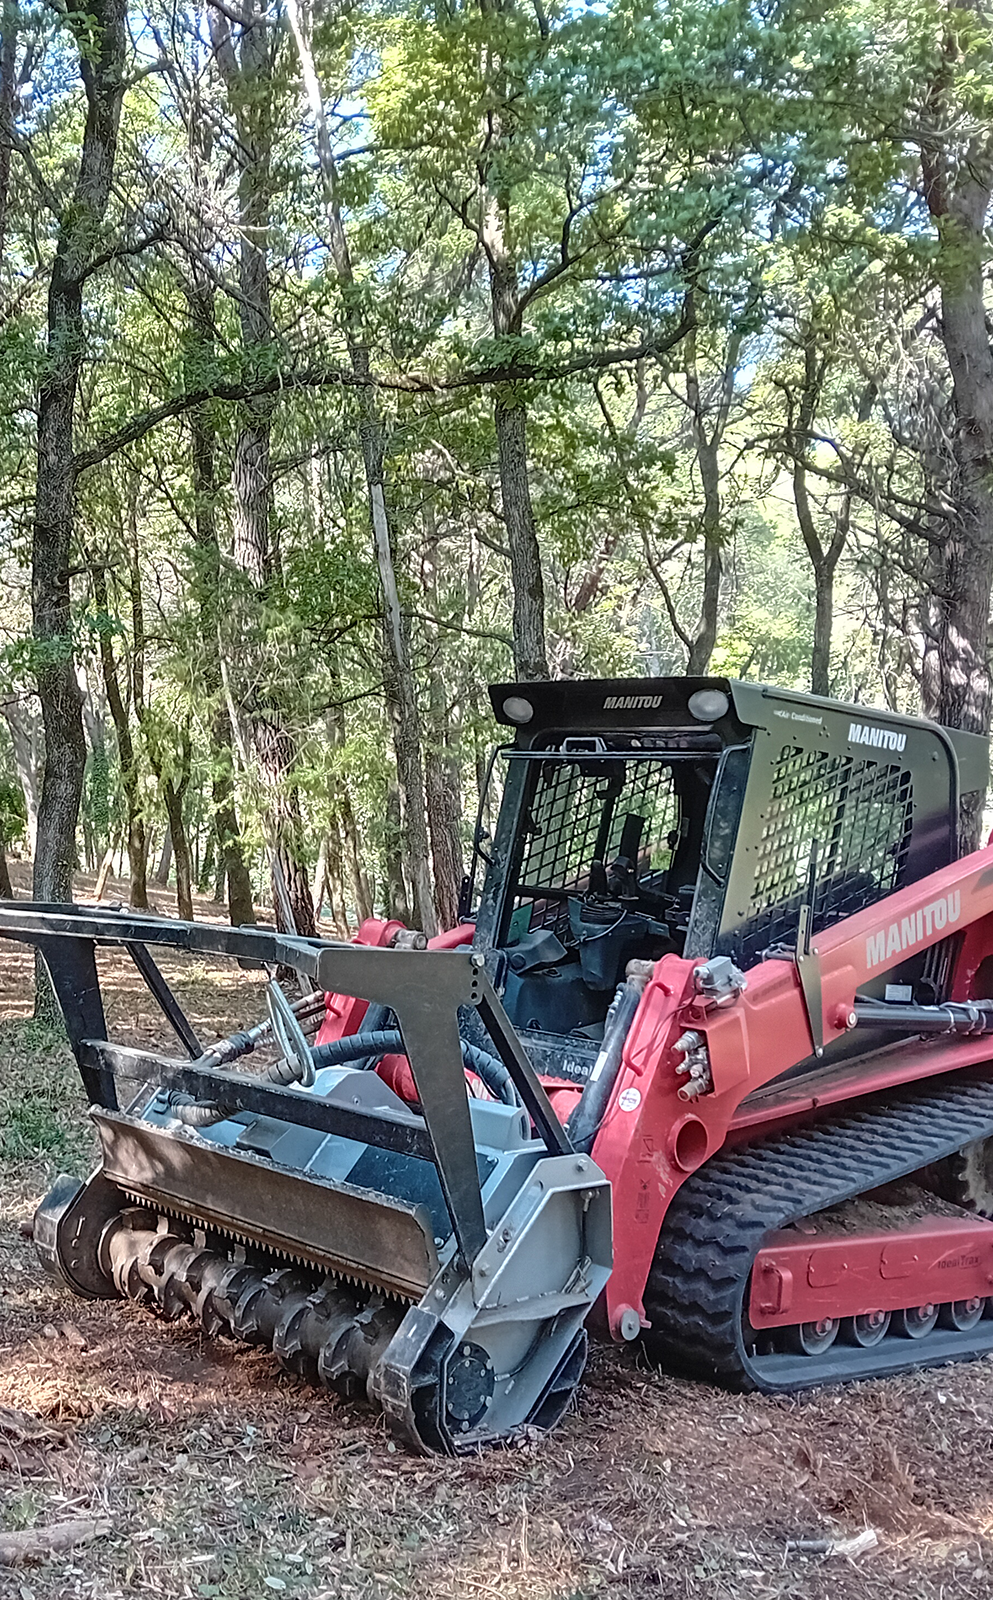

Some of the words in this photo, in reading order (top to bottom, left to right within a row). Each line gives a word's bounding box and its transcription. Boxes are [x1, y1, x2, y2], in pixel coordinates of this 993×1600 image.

[602, 695, 663, 709] MANITOU
[847, 722, 907, 752] MANITOU
[866, 889, 960, 969] MANITOU
[562, 1060, 593, 1076] Ideal
